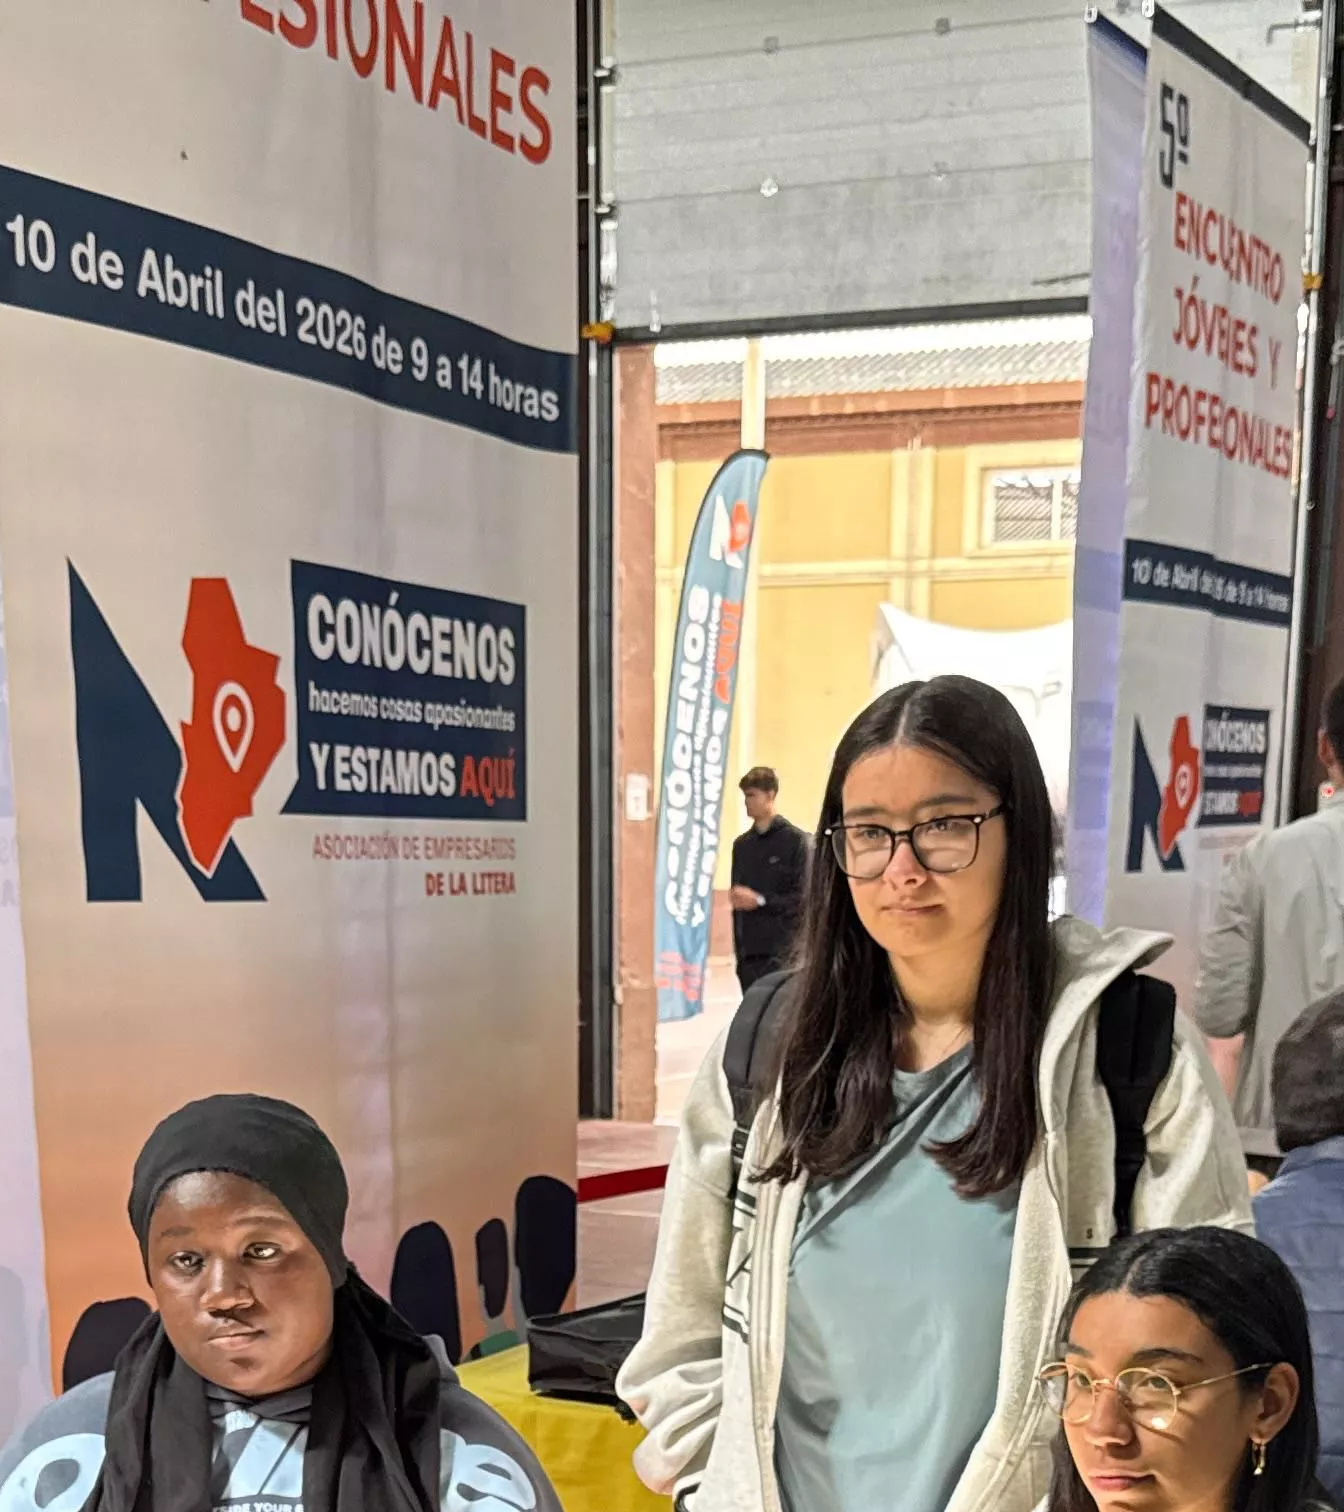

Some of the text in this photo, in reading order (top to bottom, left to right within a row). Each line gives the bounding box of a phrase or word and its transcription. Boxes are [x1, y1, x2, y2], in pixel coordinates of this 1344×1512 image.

[6, 213, 560, 423] 10 de Abril del 2026 de 9 a 14 horas
[1268, 335, 1283, 391] Y
[1131, 556, 1153, 585] 10
[1172, 562, 1200, 593] Abril
[306, 589, 517, 686] CONÓCENOS
[308, 680, 516, 733] hacemos cosas apasionantes
[309, 740, 517, 808] Y ESTAMOS AQUÍ
[312, 827, 517, 861] ASOCIACIÓN DE EMPRESARIOS
[424, 870, 517, 897] DE LA LITERA
